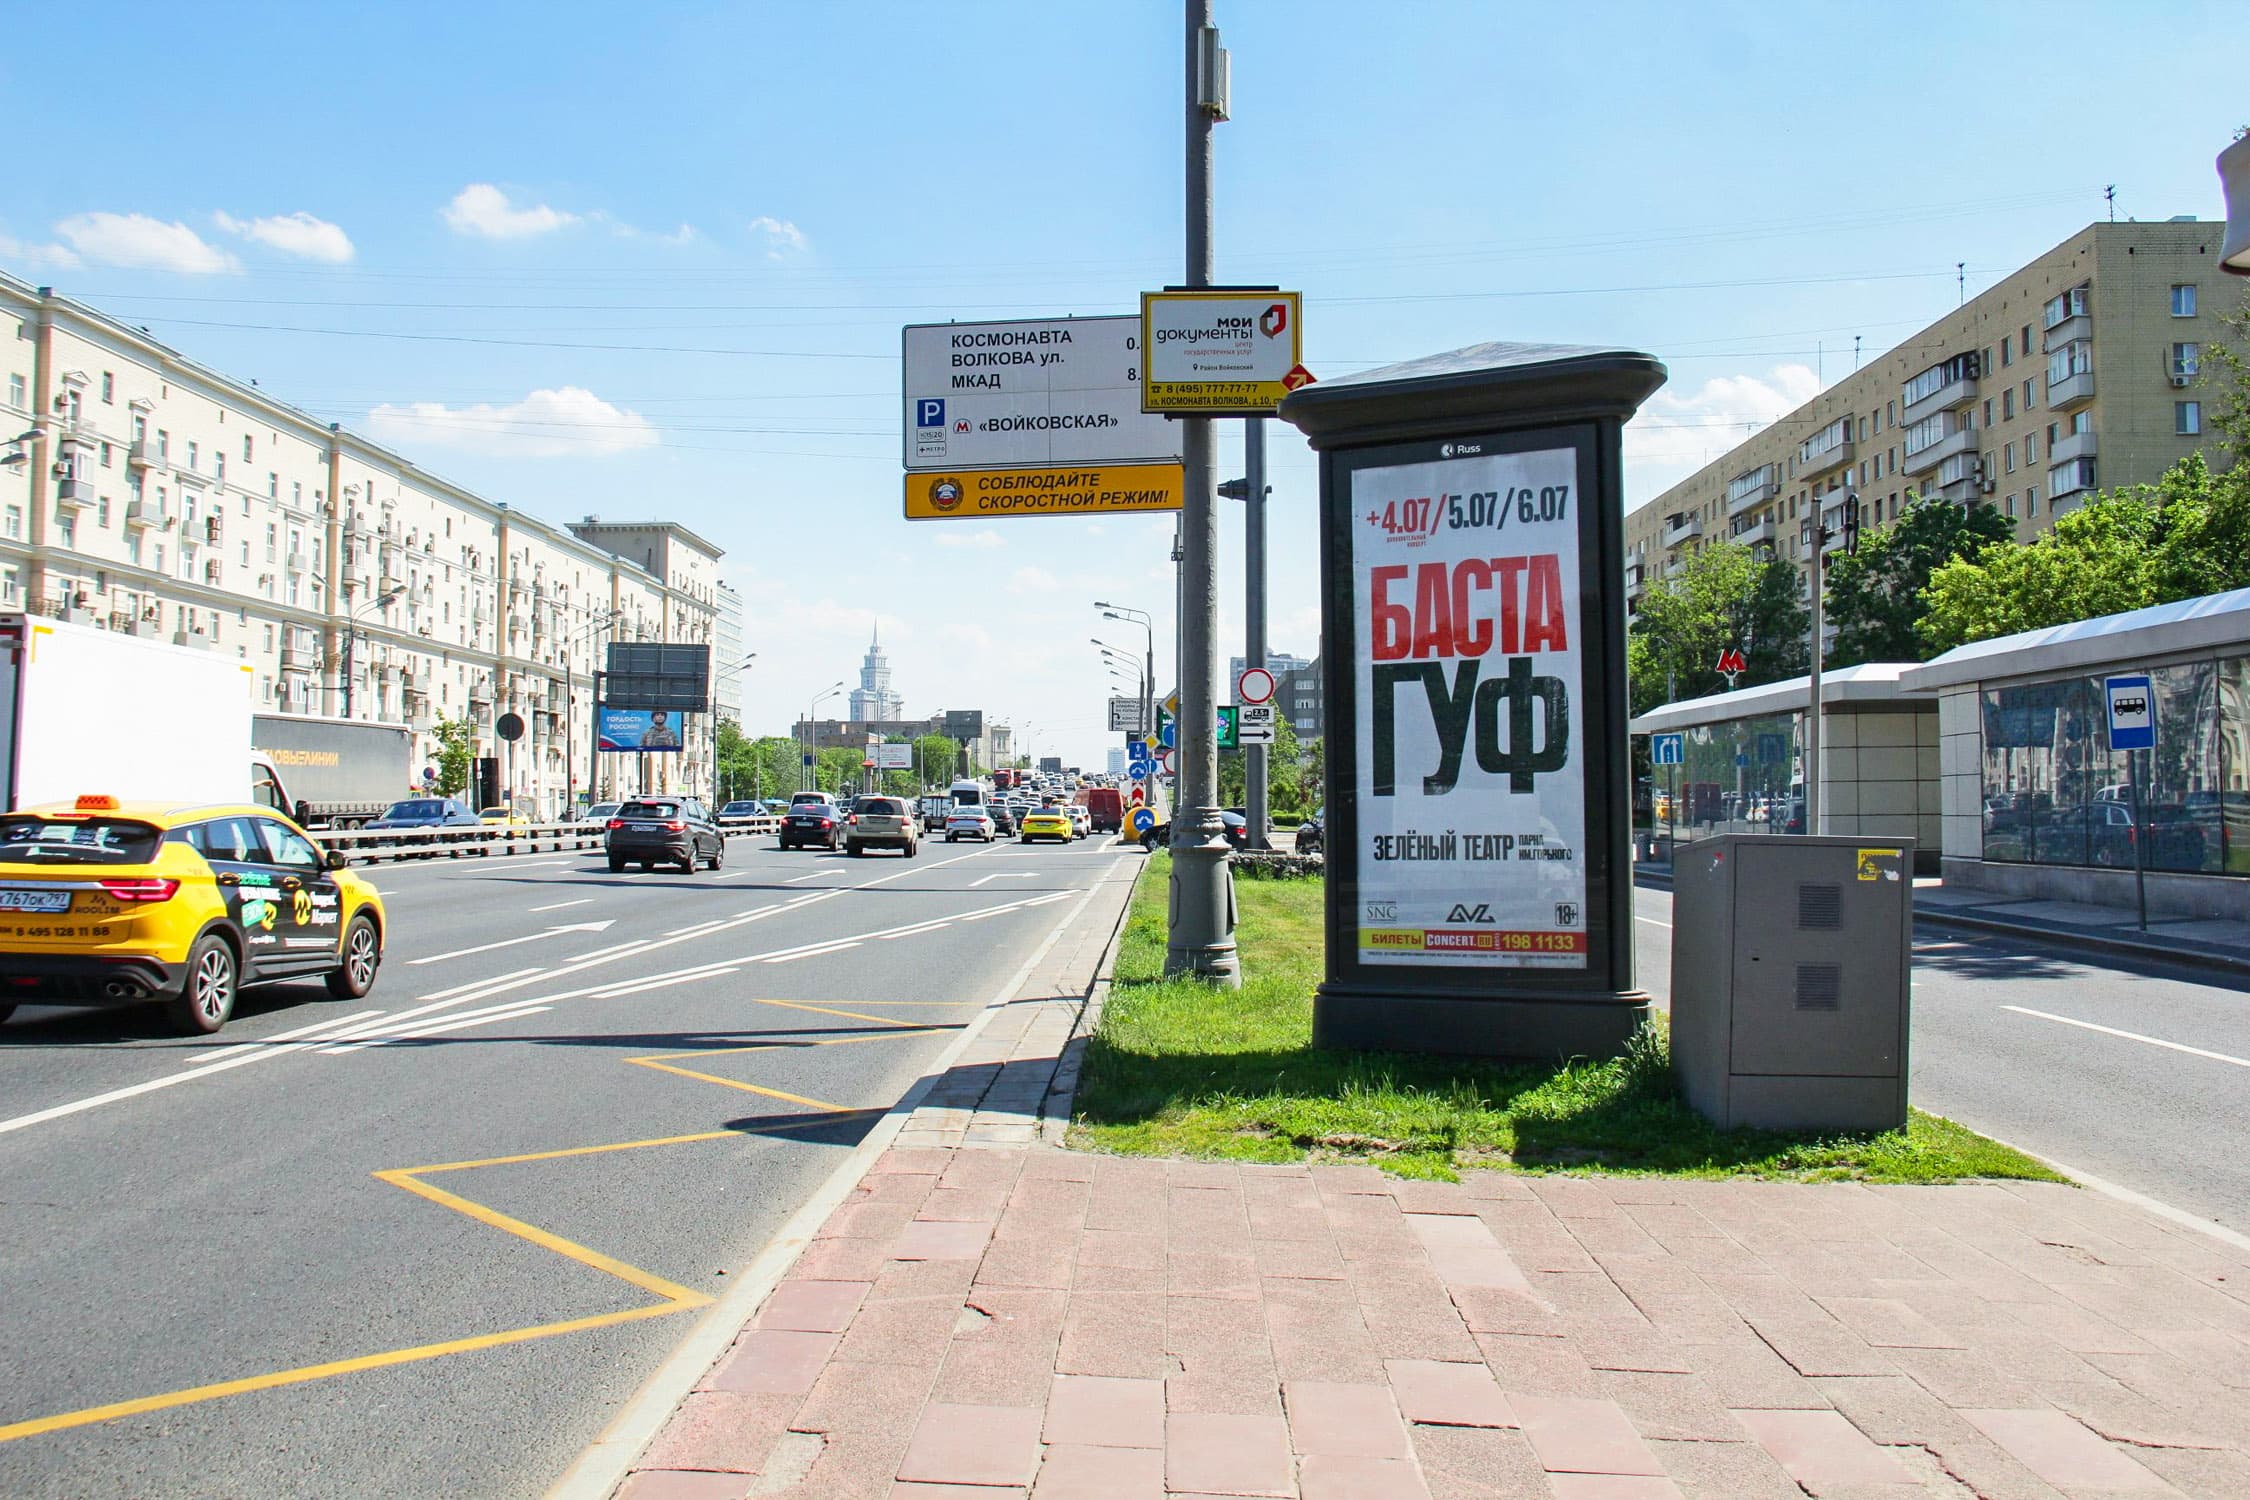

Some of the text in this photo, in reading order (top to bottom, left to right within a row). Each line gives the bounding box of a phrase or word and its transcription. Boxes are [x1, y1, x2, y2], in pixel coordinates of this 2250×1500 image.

[1218, 318, 1252, 328] мои
[952, 330, 1072, 348] КОСМОНАВТА
[1126, 338, 1140, 350] 0.
[1157, 329, 1252, 344] документы
[952, 351, 1064, 368] ВОЛКОВА ул.
[952, 373, 1002, 390] МКАД
[1127, 368, 1140, 381] 8.
[1166, 384, 1258, 394] 8 (495) 777-77-77
[1161, 396, 1210, 406] КОСМОНАВТА
[1213, 396, 1252, 406] ВОЛКОВА,
[980, 413, 1118, 432] «ВОЙКОВСКАЯ»
[1457, 444, 1481, 454] Russ
[978, 474, 1100, 491] СОБЛЮДАЙТЕ
[978, 490, 1168, 510] СКОРОСТНОЙ РЕЖИМ!
[1371, 554, 1568, 660] БАСТА
[1372, 657, 1570, 796] ГУФ
[1374, 830, 1514, 861] ЗЕЛЁНЫЙ ТЕАТР
[1367, 905, 1398, 918] SNC
[1556, 905, 1577, 924] 18+
[1372, 933, 1422, 945] БИЛЕТЫ
[1503, 935, 1530, 950] 198
[1536, 936, 1574, 950] 1133
